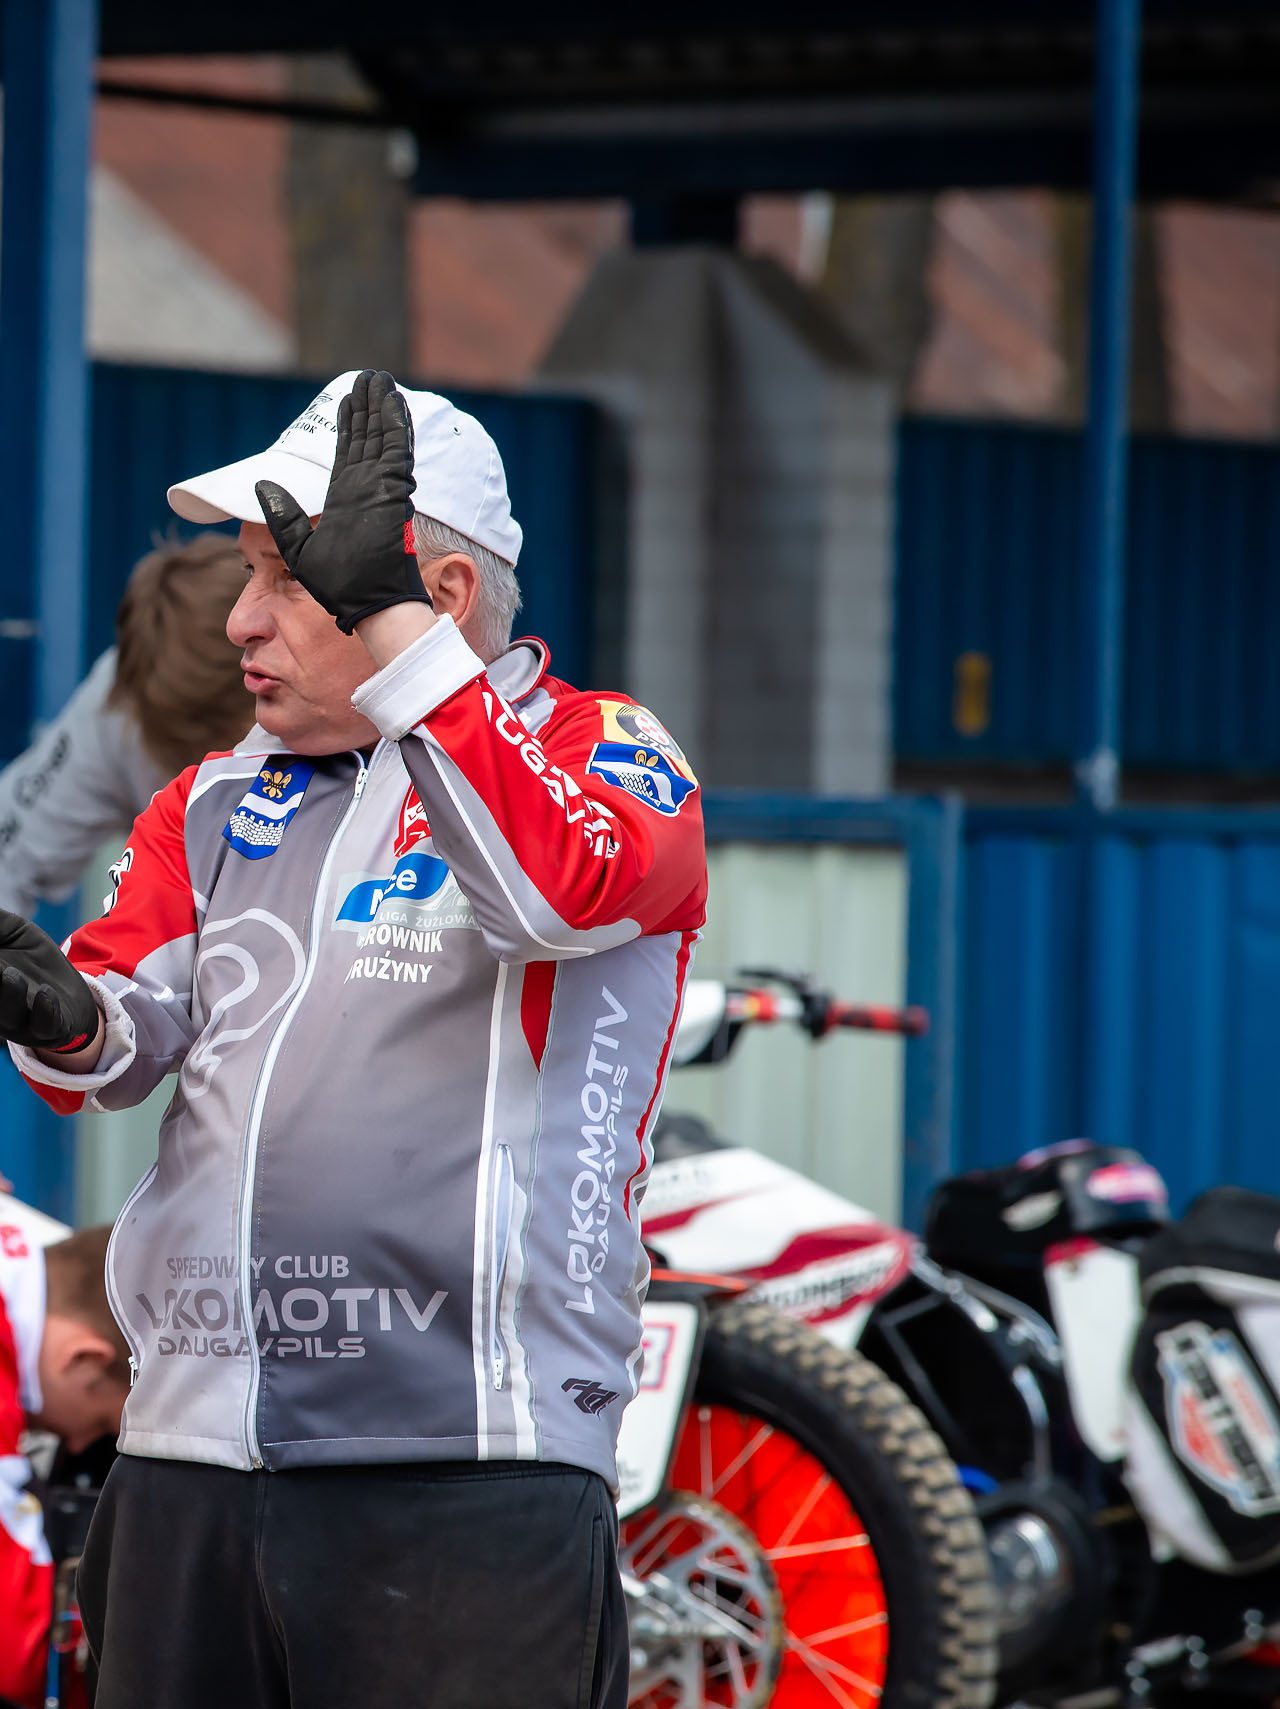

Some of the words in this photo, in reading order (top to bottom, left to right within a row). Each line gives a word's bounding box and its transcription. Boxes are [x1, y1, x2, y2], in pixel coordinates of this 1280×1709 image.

[369, 868, 418, 916] Nce
[379, 910, 408, 923] LIGA
[564, 984, 629, 1315] LOKOMOTIV
[591, 1063, 629, 1274] DAUGAVPILS
[166, 1255, 267, 1280] SPEEDWY
[274, 1255, 350, 1279] CLUB
[135, 1287, 450, 1333] LKOMOTIV
